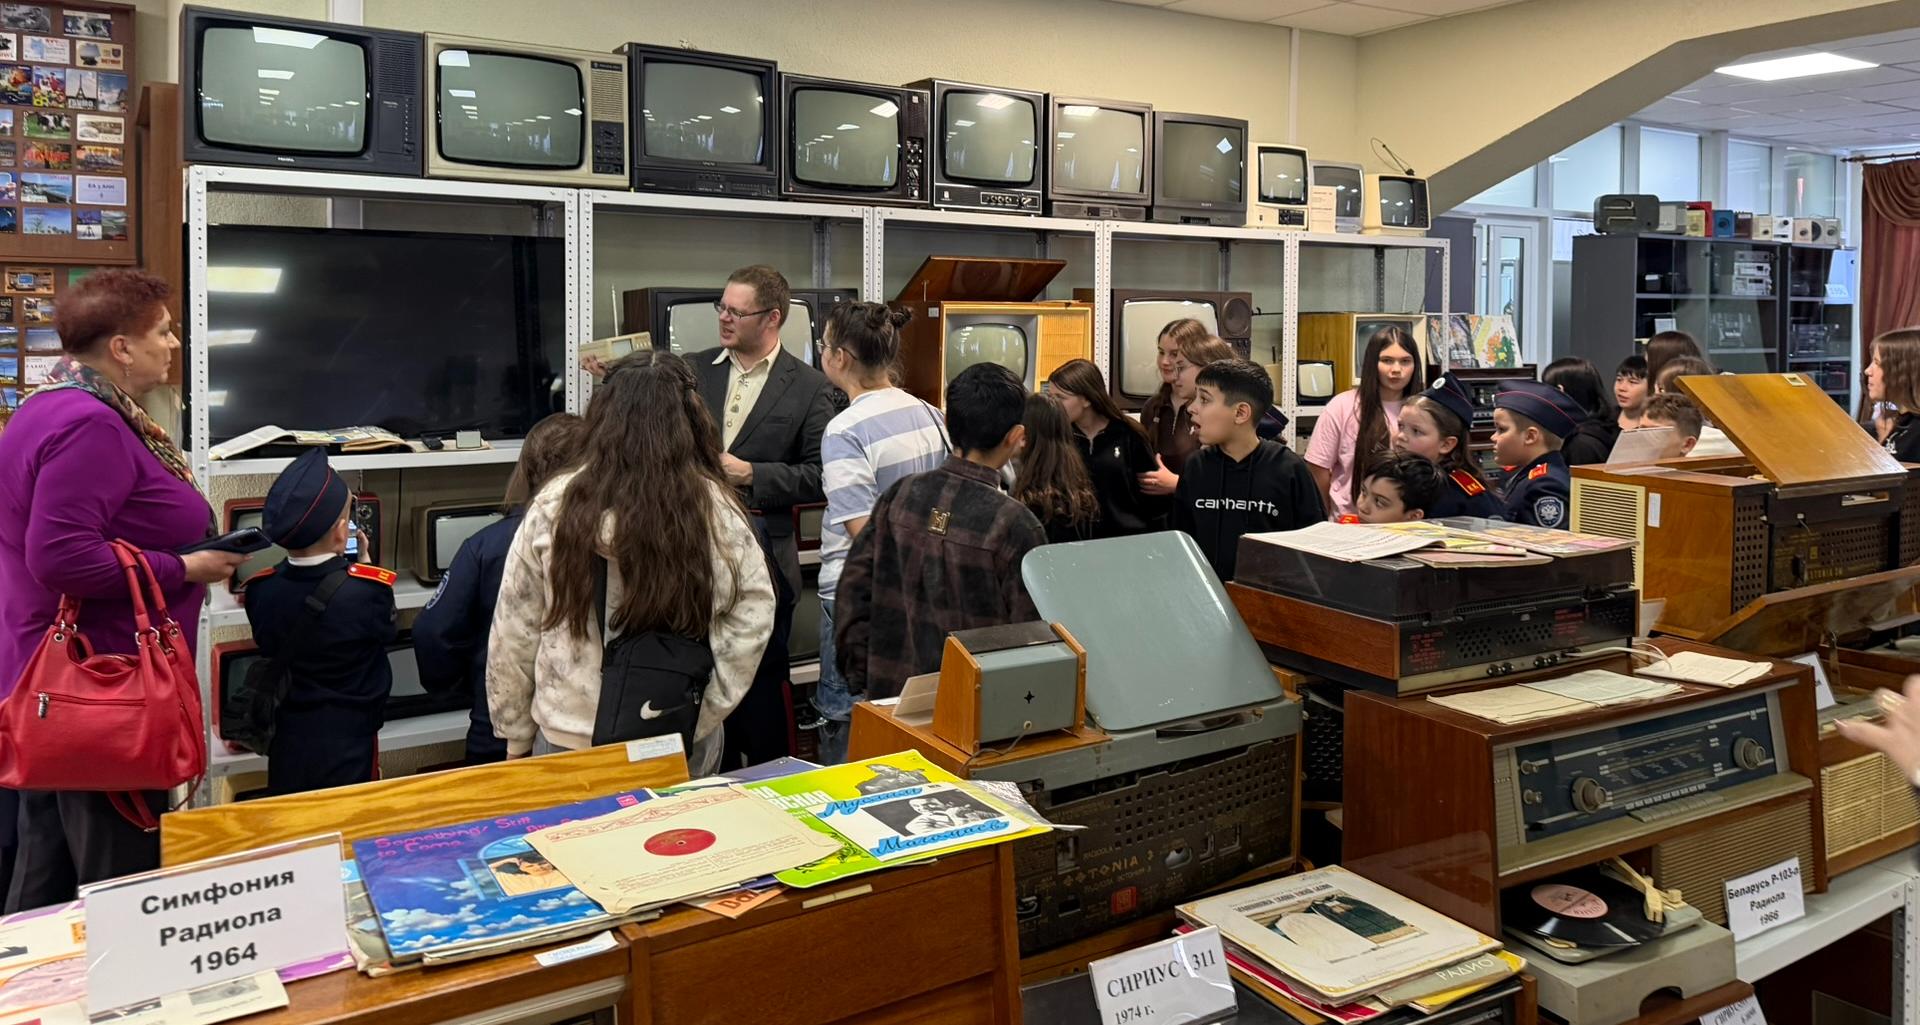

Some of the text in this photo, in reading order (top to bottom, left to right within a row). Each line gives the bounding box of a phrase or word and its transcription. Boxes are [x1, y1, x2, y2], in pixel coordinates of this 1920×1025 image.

[1195, 497, 1276, 515] carhartt
[141, 868, 296, 915] Симфония
[1728, 878, 1770, 900] Беларусь
[1750, 891, 1785, 912] Радиола
[159, 904, 283, 946] Радиола
[1760, 910, 1780, 926] 1966
[190, 941, 259, 974] 1964
[1106, 960, 1180, 998] СИРИУС
[1192, 949, 1217, 971] 311
[1436, 957, 1497, 984] РАДИО
[1115, 1004, 1155, 1025] 1974 г.
